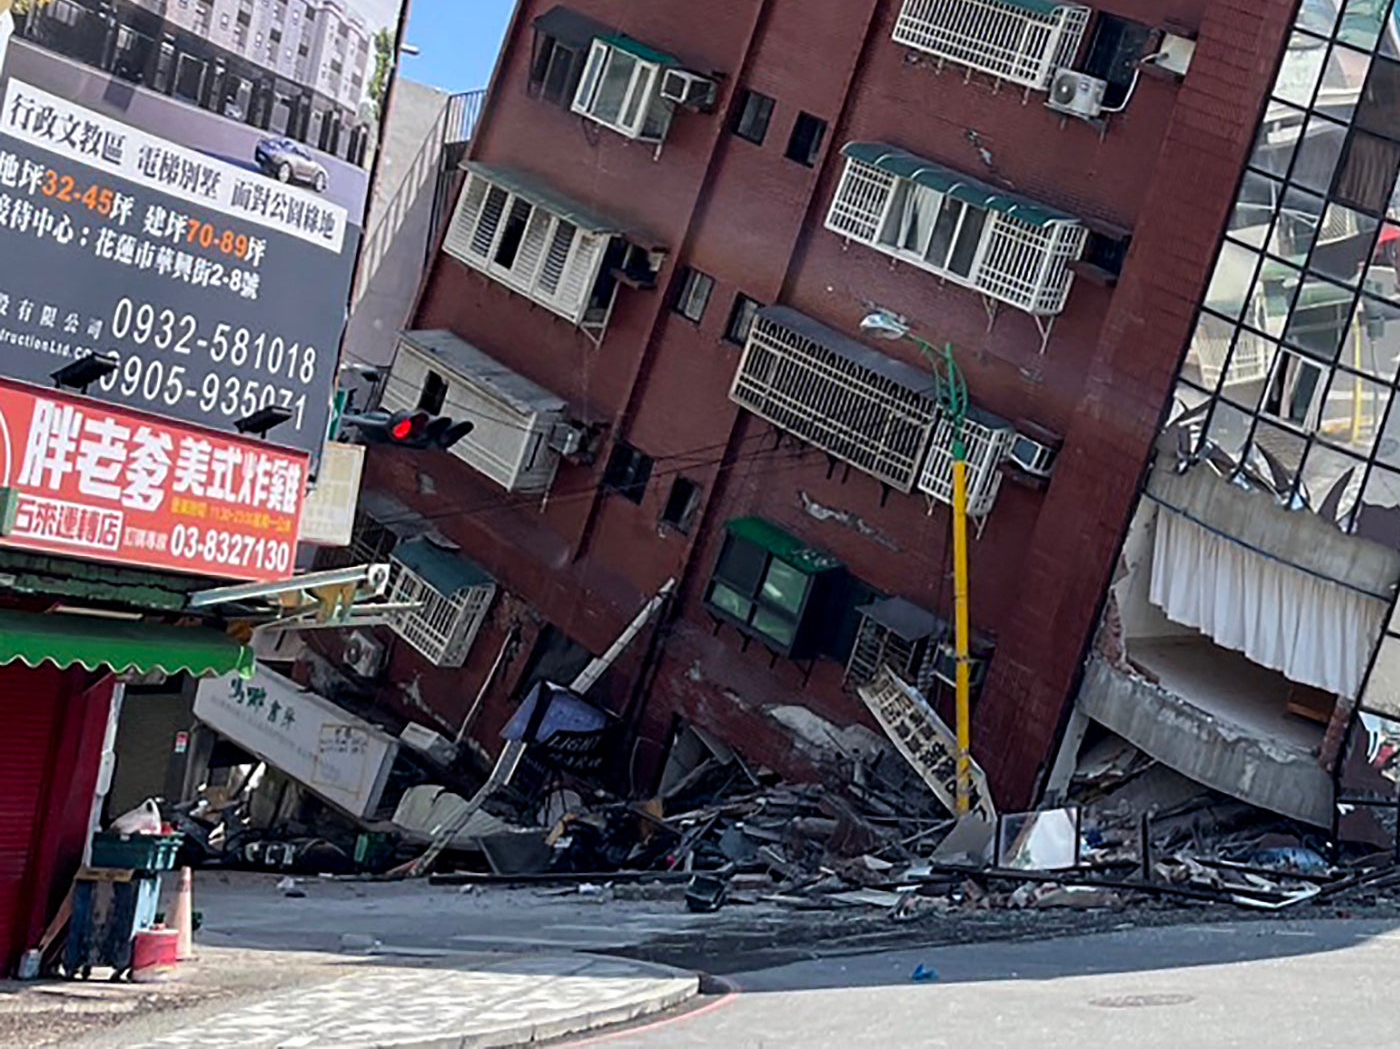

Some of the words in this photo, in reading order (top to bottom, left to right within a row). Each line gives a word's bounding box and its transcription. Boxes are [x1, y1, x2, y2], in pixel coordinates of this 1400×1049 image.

[10, 93, 126, 165] 行政文教區
[137, 144, 221, 199] 電梯別墅
[230, 177, 336, 239] 面對公園綠地
[112, 297, 316, 384] 0932-581018
[99, 350, 306, 431] 0905-935071
[170, 523, 290, 573] 03-8327130
